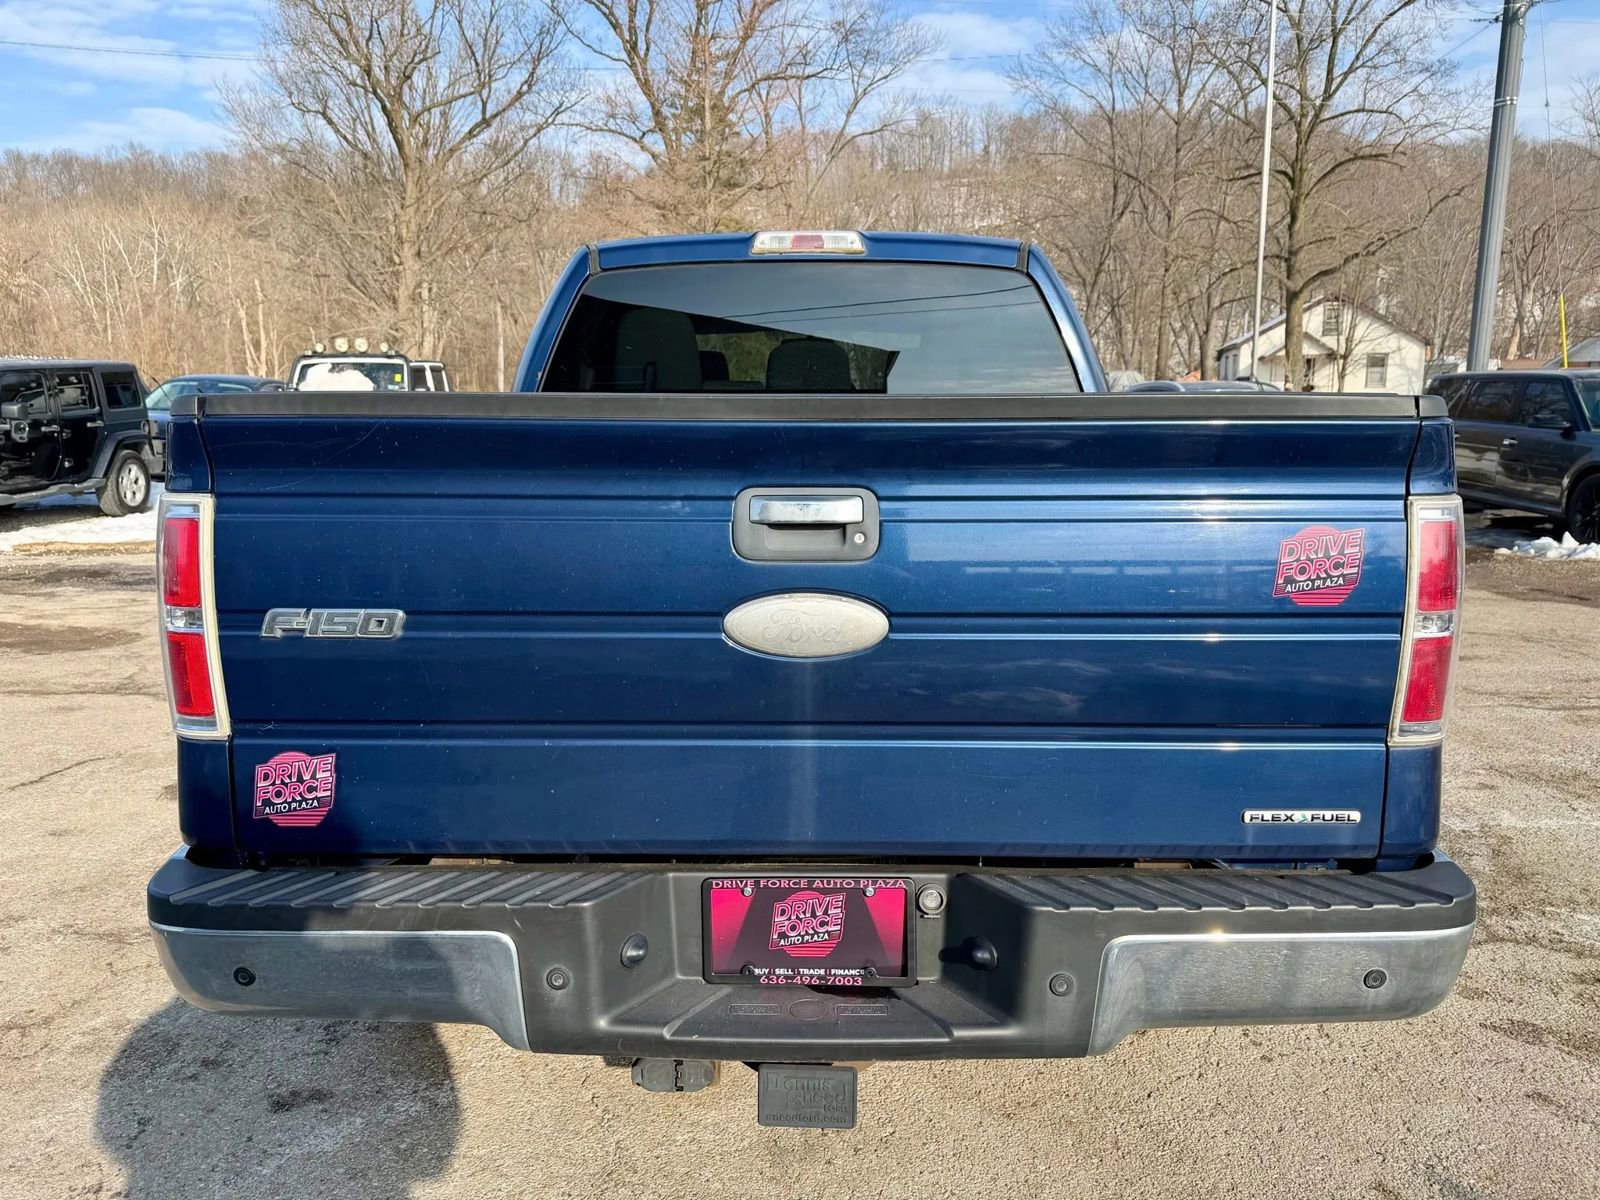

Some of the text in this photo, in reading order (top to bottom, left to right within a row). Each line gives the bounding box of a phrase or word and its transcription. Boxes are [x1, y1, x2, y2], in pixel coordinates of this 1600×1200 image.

[1281, 531, 1362, 563] DRIVE
[1278, 552, 1361, 584] FORCE
[1285, 577, 1344, 593] AUTO PLAZA
[260, 608, 406, 639] F-150
[761, 608, 847, 644] Ford
[257, 757, 333, 787] DRIVE
[257, 777, 333, 806] FORCE
[264, 799, 319, 815] AUTO PLAZA
[1249, 813, 1357, 822] FLEX FUEL
[712, 880, 906, 889] DRIVE FORCE AUTO PLAZA
[774, 895, 844, 922] DRIVE
[772, 912, 843, 939] FORCE
[779, 933, 829, 946] AUTO PLAZA
[760, 975, 862, 986] 636-496-7003
